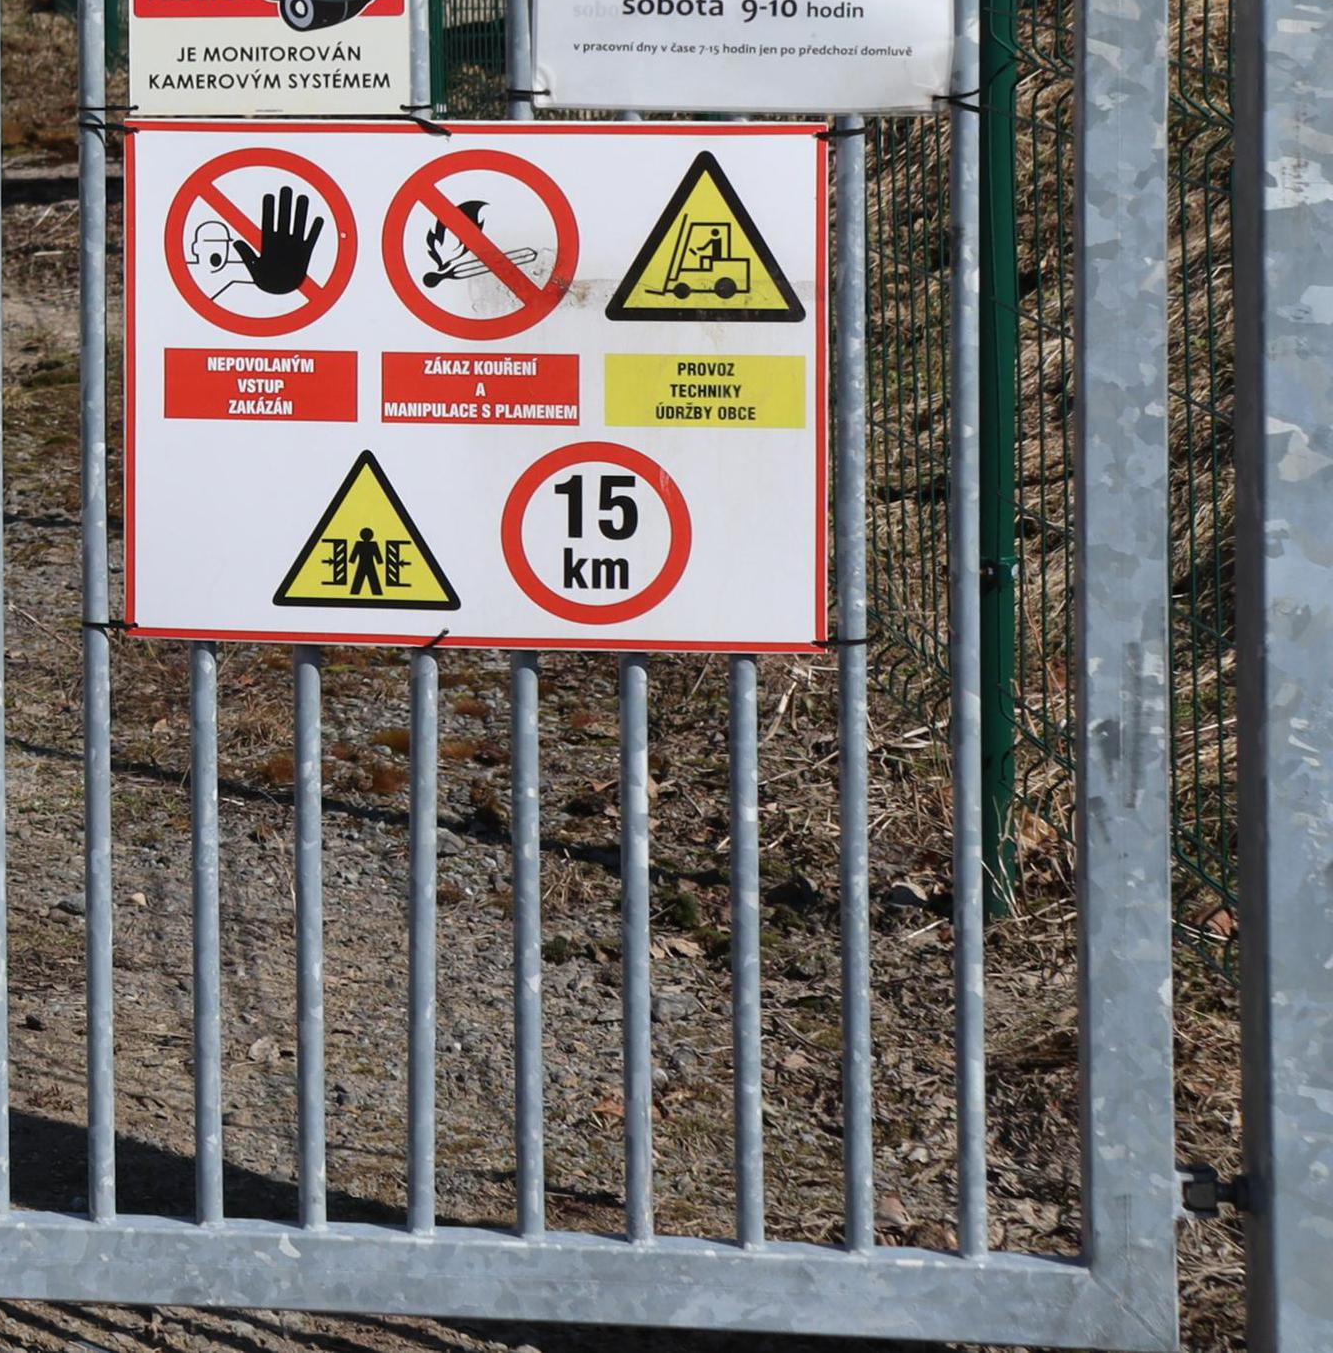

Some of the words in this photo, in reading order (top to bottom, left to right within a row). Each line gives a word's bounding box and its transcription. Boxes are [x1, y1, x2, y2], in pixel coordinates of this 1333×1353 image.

[806, 0, 864, 19] hodin
[176, 46, 197, 63] JE
[203, 40, 361, 63] MONITOROVÁN
[573, 43, 581, 51] v
[582, 41, 634, 54] pracovní
[635, 41, 658, 55] dny
[660, 45, 668, 53] v
[670, 42, 697, 54] čase
[722, 43, 757, 54] hodin
[758, 44, 778, 57] jen
[780, 46, 796, 58] po
[798, 44, 859, 58] předchozí
[860, 45, 913, 57] domluvě
[148, 68, 282, 90] KAMEROVÝM
[288, 68, 391, 89] SYSTÉMEM
[207, 354, 315, 373] NEPOVOLANÝM
[424, 356, 471, 375] ZÁKAZ
[473, 357, 538, 376] KOUŘENÍ
[677, 361, 735, 377] PROVOZ
[237, 378, 285, 394] VSTUP
[475, 382, 486, 397] A
[669, 383, 742, 399] TECHNIKY
[228, 396, 293, 415] ZAKÁZÁN
[384, 402, 478, 418] MANIPULACE
[481, 403, 492, 419] S
[495, 403, 578, 420] PLAMENEM
[655, 401, 713, 420] ÚDRŽBY
[717, 405, 756, 421] OBCE
[554, 475, 638, 540] 15
[563, 547, 630, 590] km
